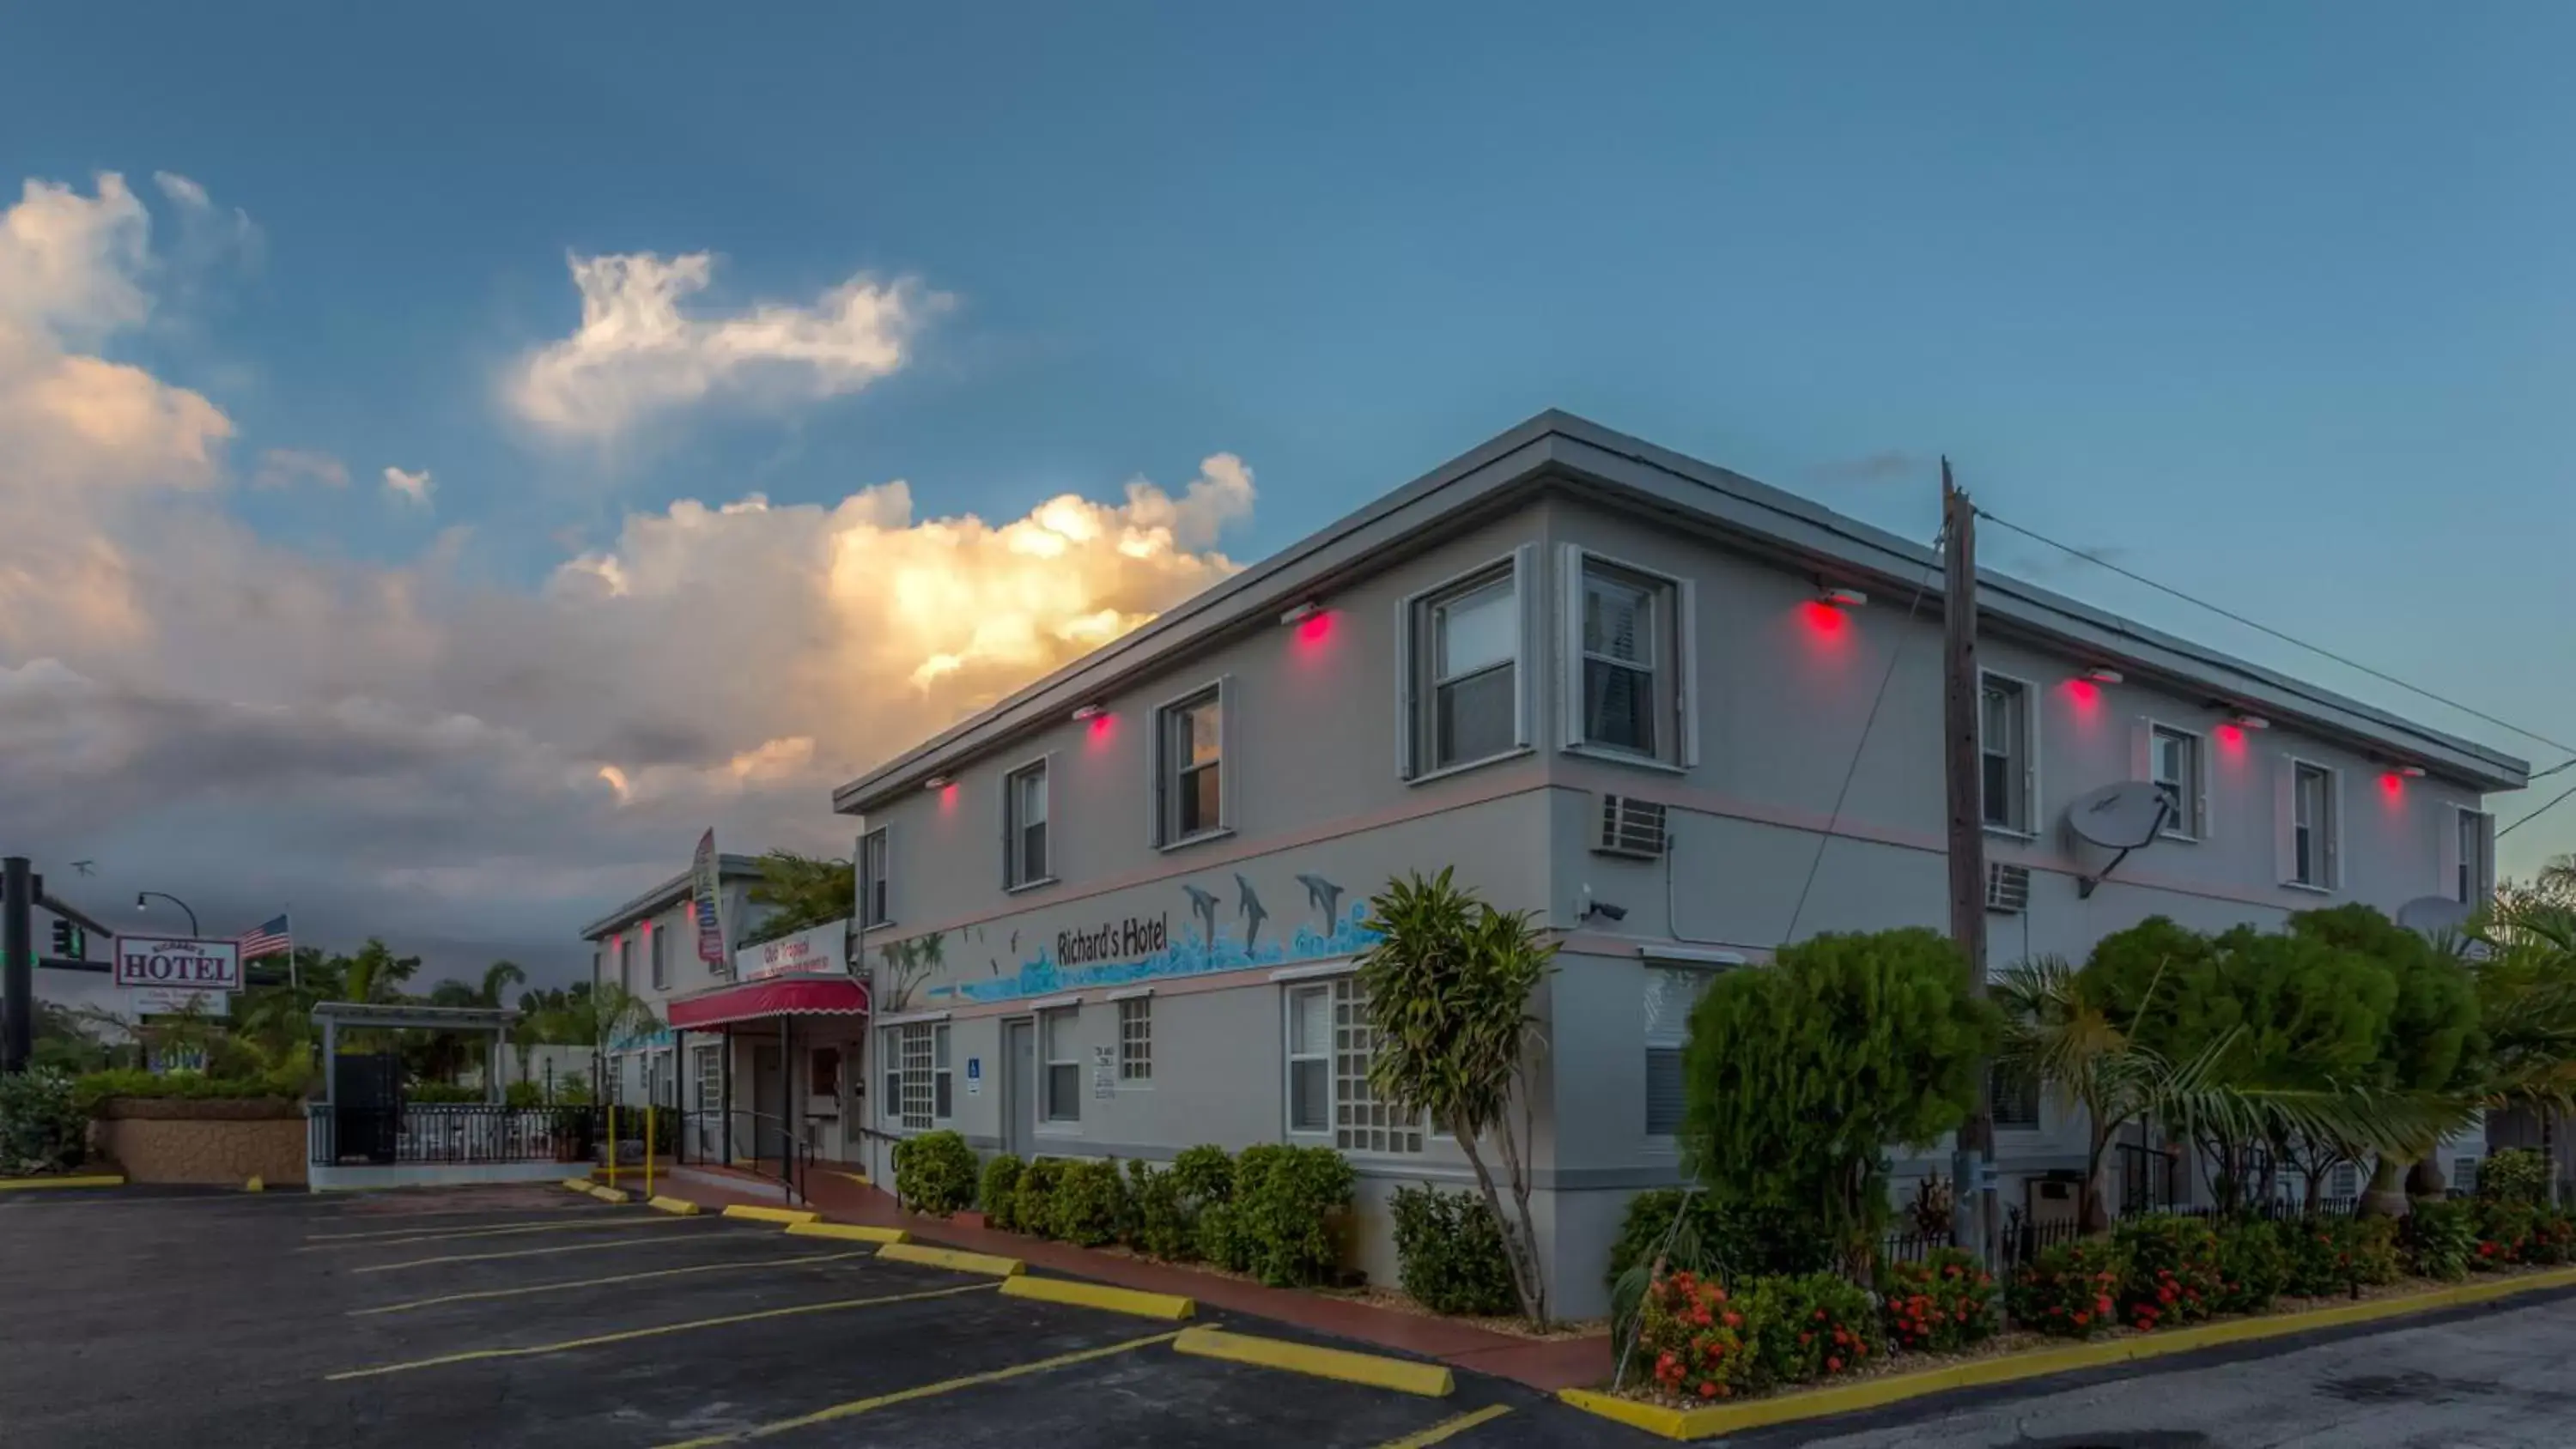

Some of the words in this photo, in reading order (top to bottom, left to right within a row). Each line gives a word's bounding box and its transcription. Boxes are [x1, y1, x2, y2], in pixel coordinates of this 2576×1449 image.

[1057, 923, 1119, 966] Richard's
[1123, 912, 1168, 957] Hotel
[124, 955, 234, 980] HOTEL
